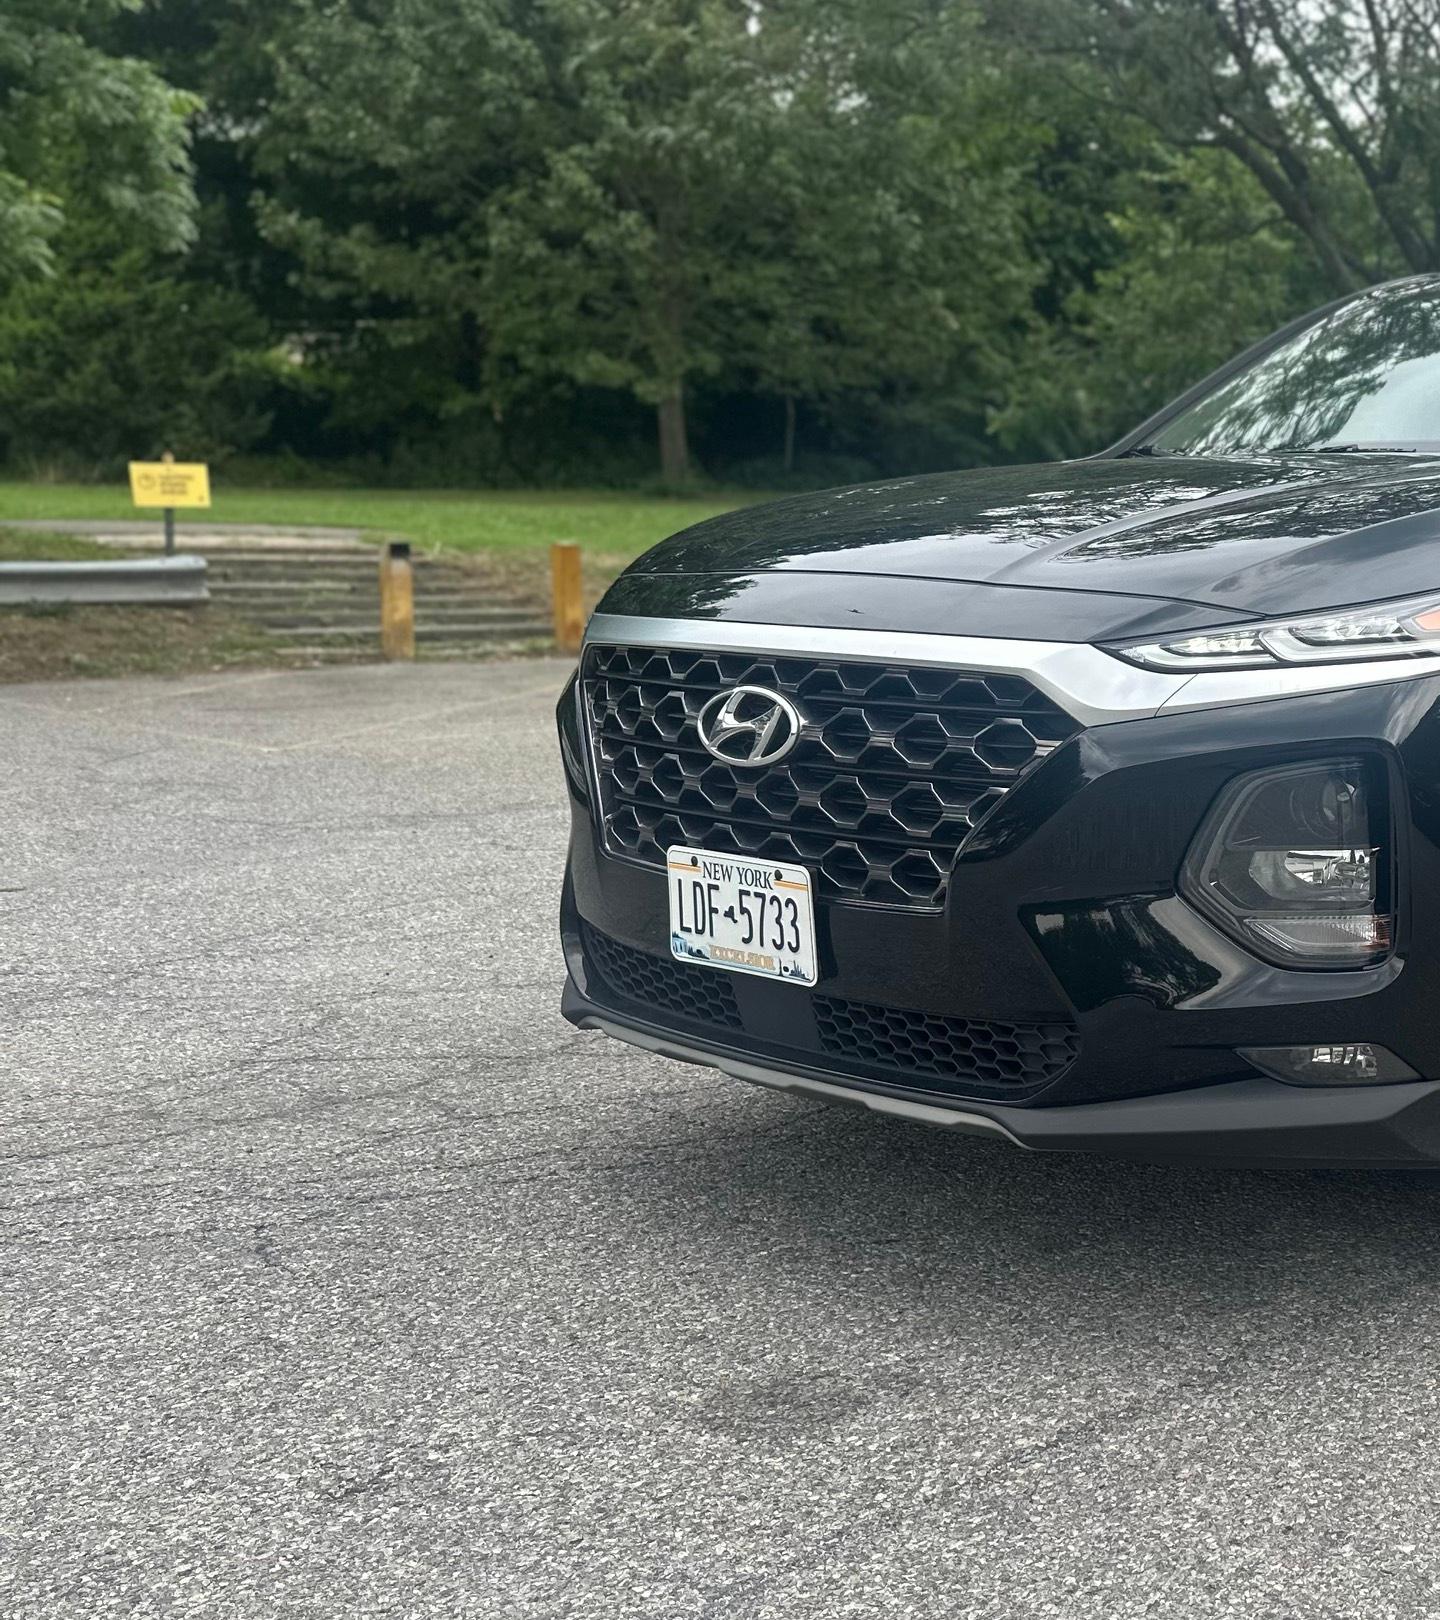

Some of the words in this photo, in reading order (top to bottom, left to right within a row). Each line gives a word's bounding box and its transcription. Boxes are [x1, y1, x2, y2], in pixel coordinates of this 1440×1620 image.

[702, 861, 734, 882] NEW
[735, 866, 773, 890] YORK
[678, 878, 720, 937] LDF
[738, 888, 800, 953] 5733
